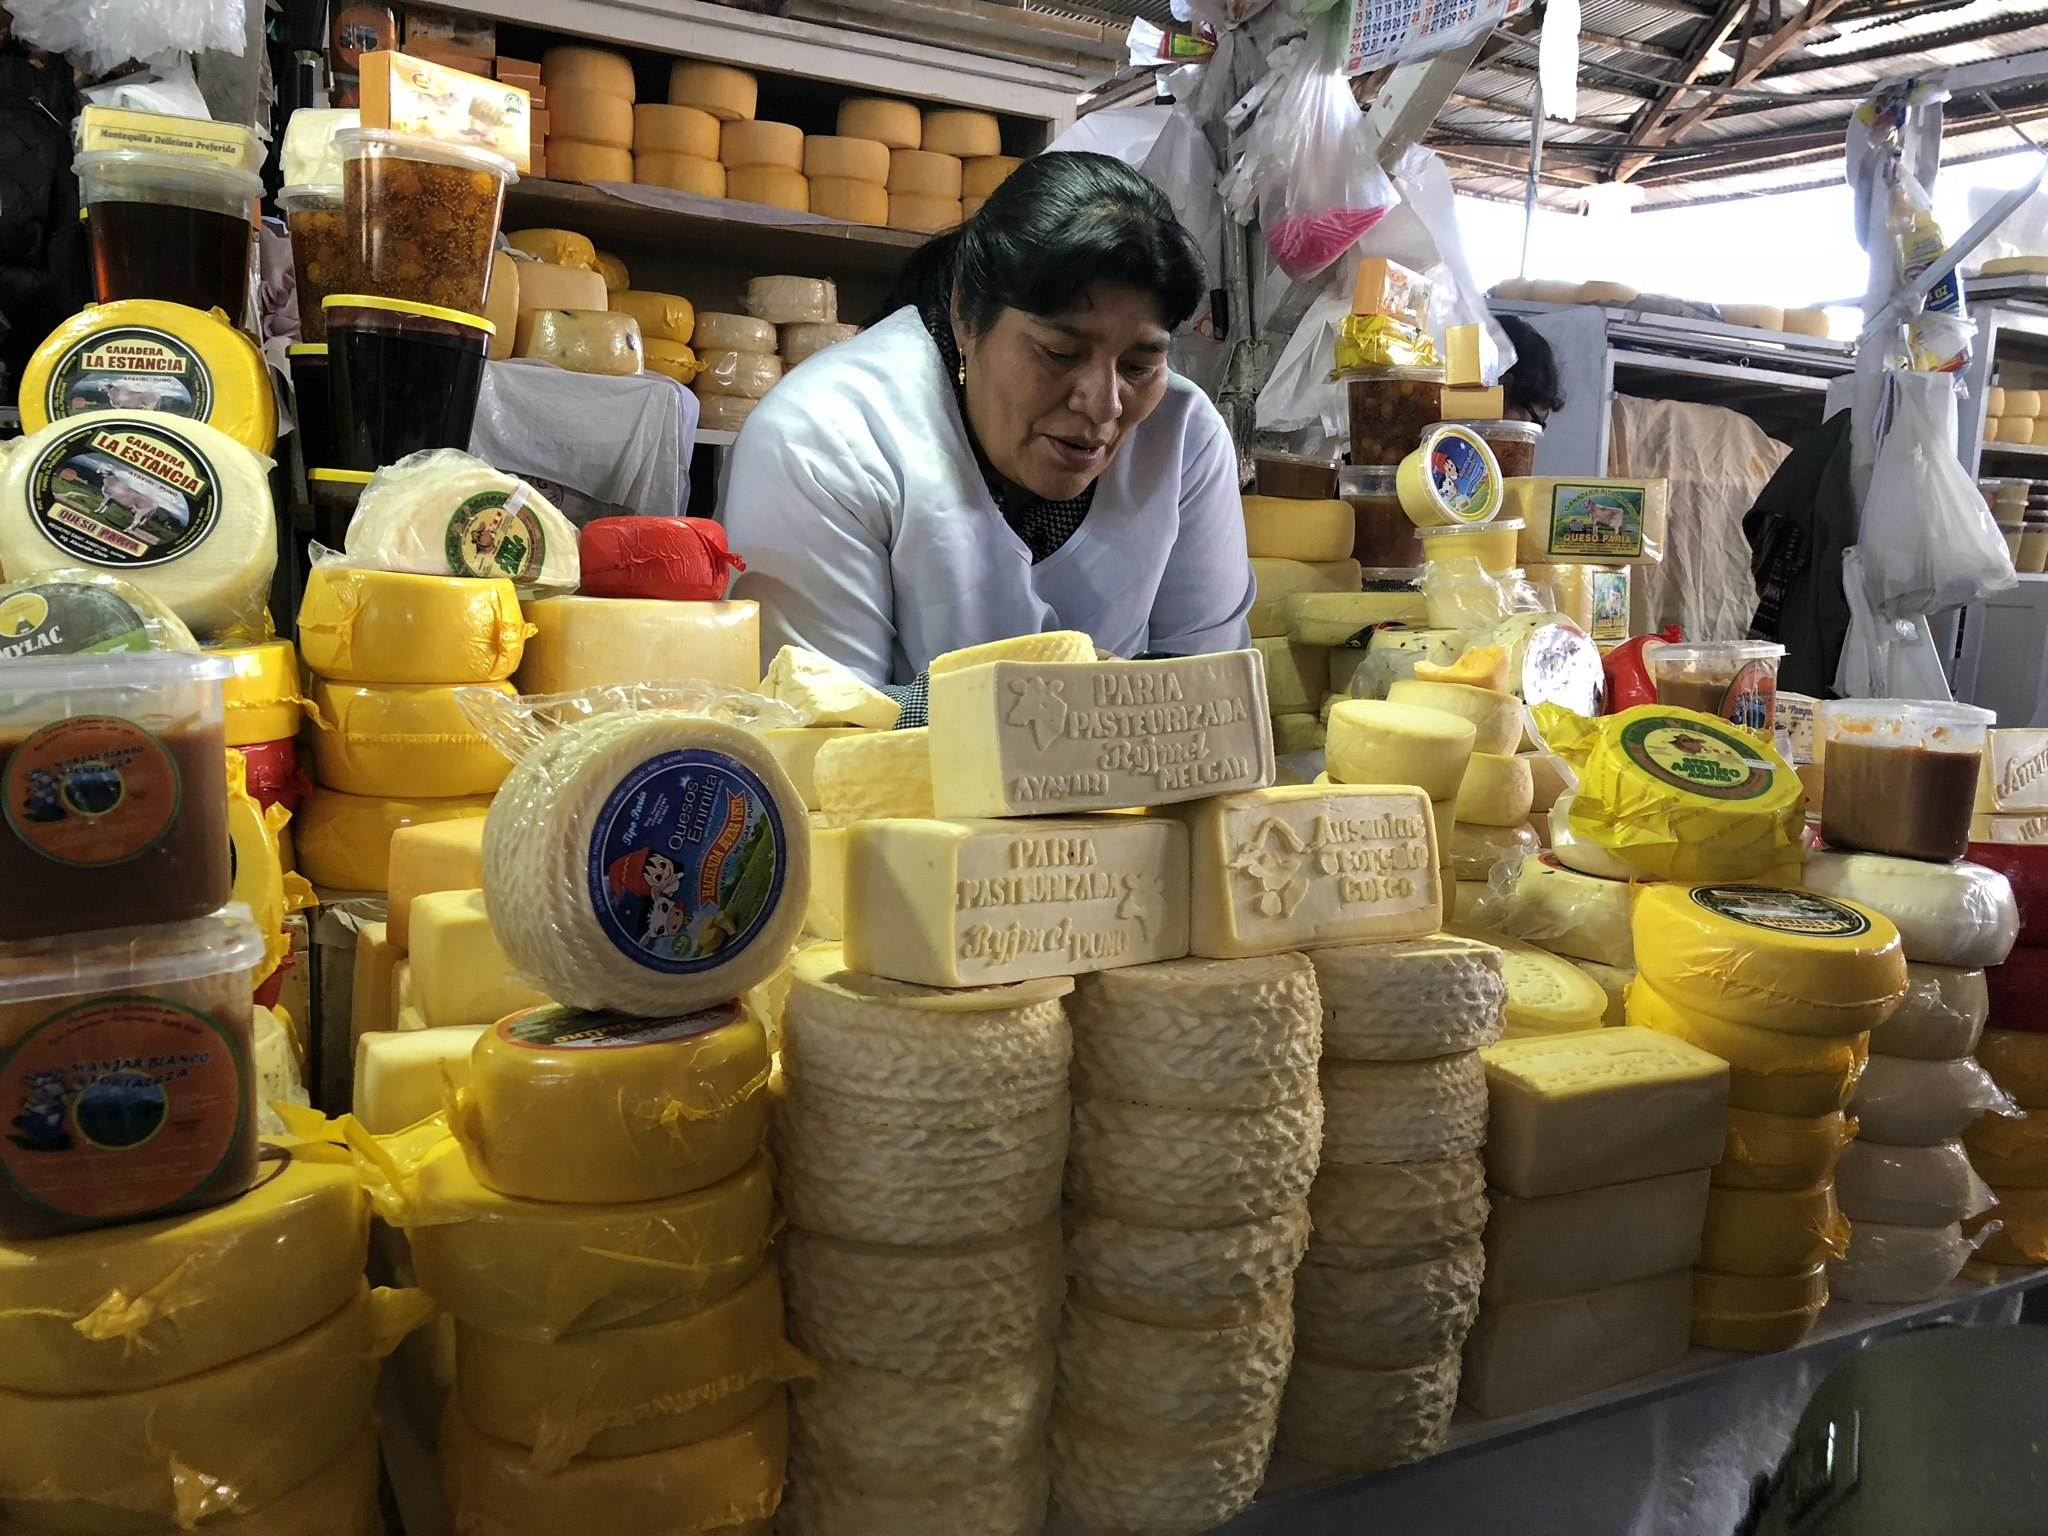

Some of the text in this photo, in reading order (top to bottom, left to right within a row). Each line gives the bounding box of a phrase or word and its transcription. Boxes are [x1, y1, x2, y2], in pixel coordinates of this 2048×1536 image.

[1353, 11, 1421, 40] 22 23 24 25 26 27 28
[1356, 12, 1363, 22] 15
[1365, 9, 1373, 20] 16
[1375, 6, 1382, 16] 17
[1384, 4, 1392, 15] 18
[1394, 2, 1401, 12] 19
[1425, 8, 1433, 19] 19
[1434, 4, 1442, 15] 20
[1430, 20, 1439, 33] 27
[1440, 17, 1447, 28] 28
[1447, 13, 1456, 24] 29
[1458, 9, 1469, 22] 30
[1469, 5, 1476, 17] 31
[1350, 37, 1378, 55] 29 30 31
[100, 129, 152, 143] Mantequilla
[154, 135, 194, 148] Deliciosa
[196, 141, 236, 154] Preferida
[1935, 284, 1949, 299] OZ
[86, 355, 183, 371] LA ESTANCIA
[106, 346, 163, 356] GANADERA
[98, 434, 120, 454] LA
[119, 449, 199, 493] ESTANCIA
[126, 435, 186, 469] GANADERA
[159, 484, 179, 498] PUNO
[58, 508, 97, 532] QUESO
[99, 527, 141, 552] PARIA
[1564, 533, 1631, 543] QUESO PARIA
[1093, 672, 1183, 706] PARIA
[1067, 697, 1248, 739] PASTEURIZADA
[1156, 756, 1248, 791] MELGAR
[622, 790, 647, 846] Tipo Paria
[668, 780, 699, 851] Quesos
[687, 774, 719, 844] Emmita
[702, 850, 724, 898] HACIENDA
[718, 821, 741, 850] BUENA
[720, 859, 732, 892] AYAVIRI
[733, 824, 751, 856] MELGAR
[1010, 837, 1098, 868] PARIA
[957, 872, 1120, 910] PASTEURIZADA
[1069, 929, 1130, 962] PUNO
[72, 1052, 209, 1073] MANJAR BLANCO
